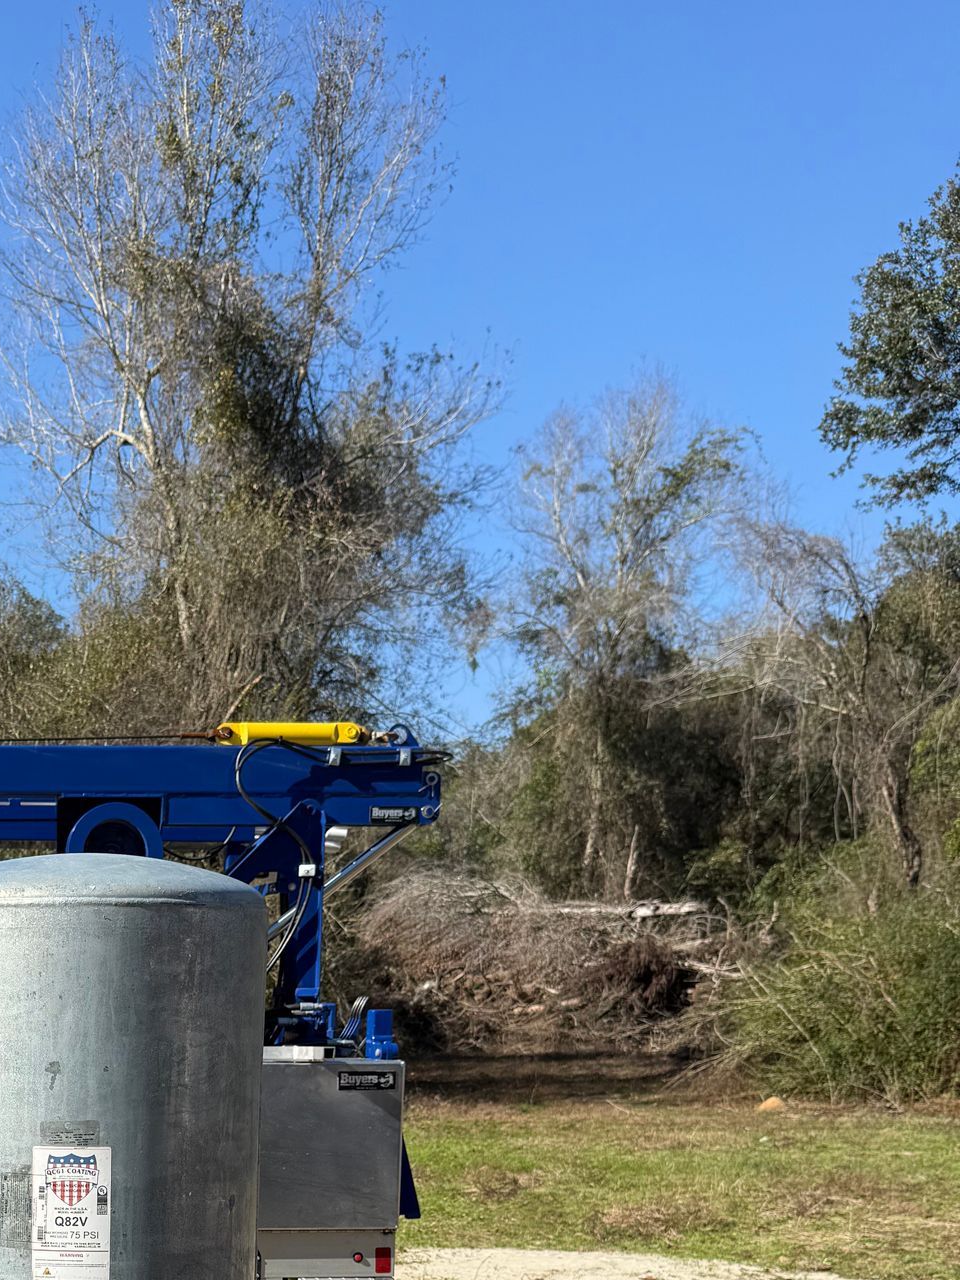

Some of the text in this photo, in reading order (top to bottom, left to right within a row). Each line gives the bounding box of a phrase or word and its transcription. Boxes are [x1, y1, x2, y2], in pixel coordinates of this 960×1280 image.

[371, 807, 403, 819] Buyers
[340, 1072, 379, 1086] Buyers
[66, 1168, 96, 1176] COATING
[54, 1216, 88, 1226] Q82V
[69, 1231, 99, 1239] 75 PSI
